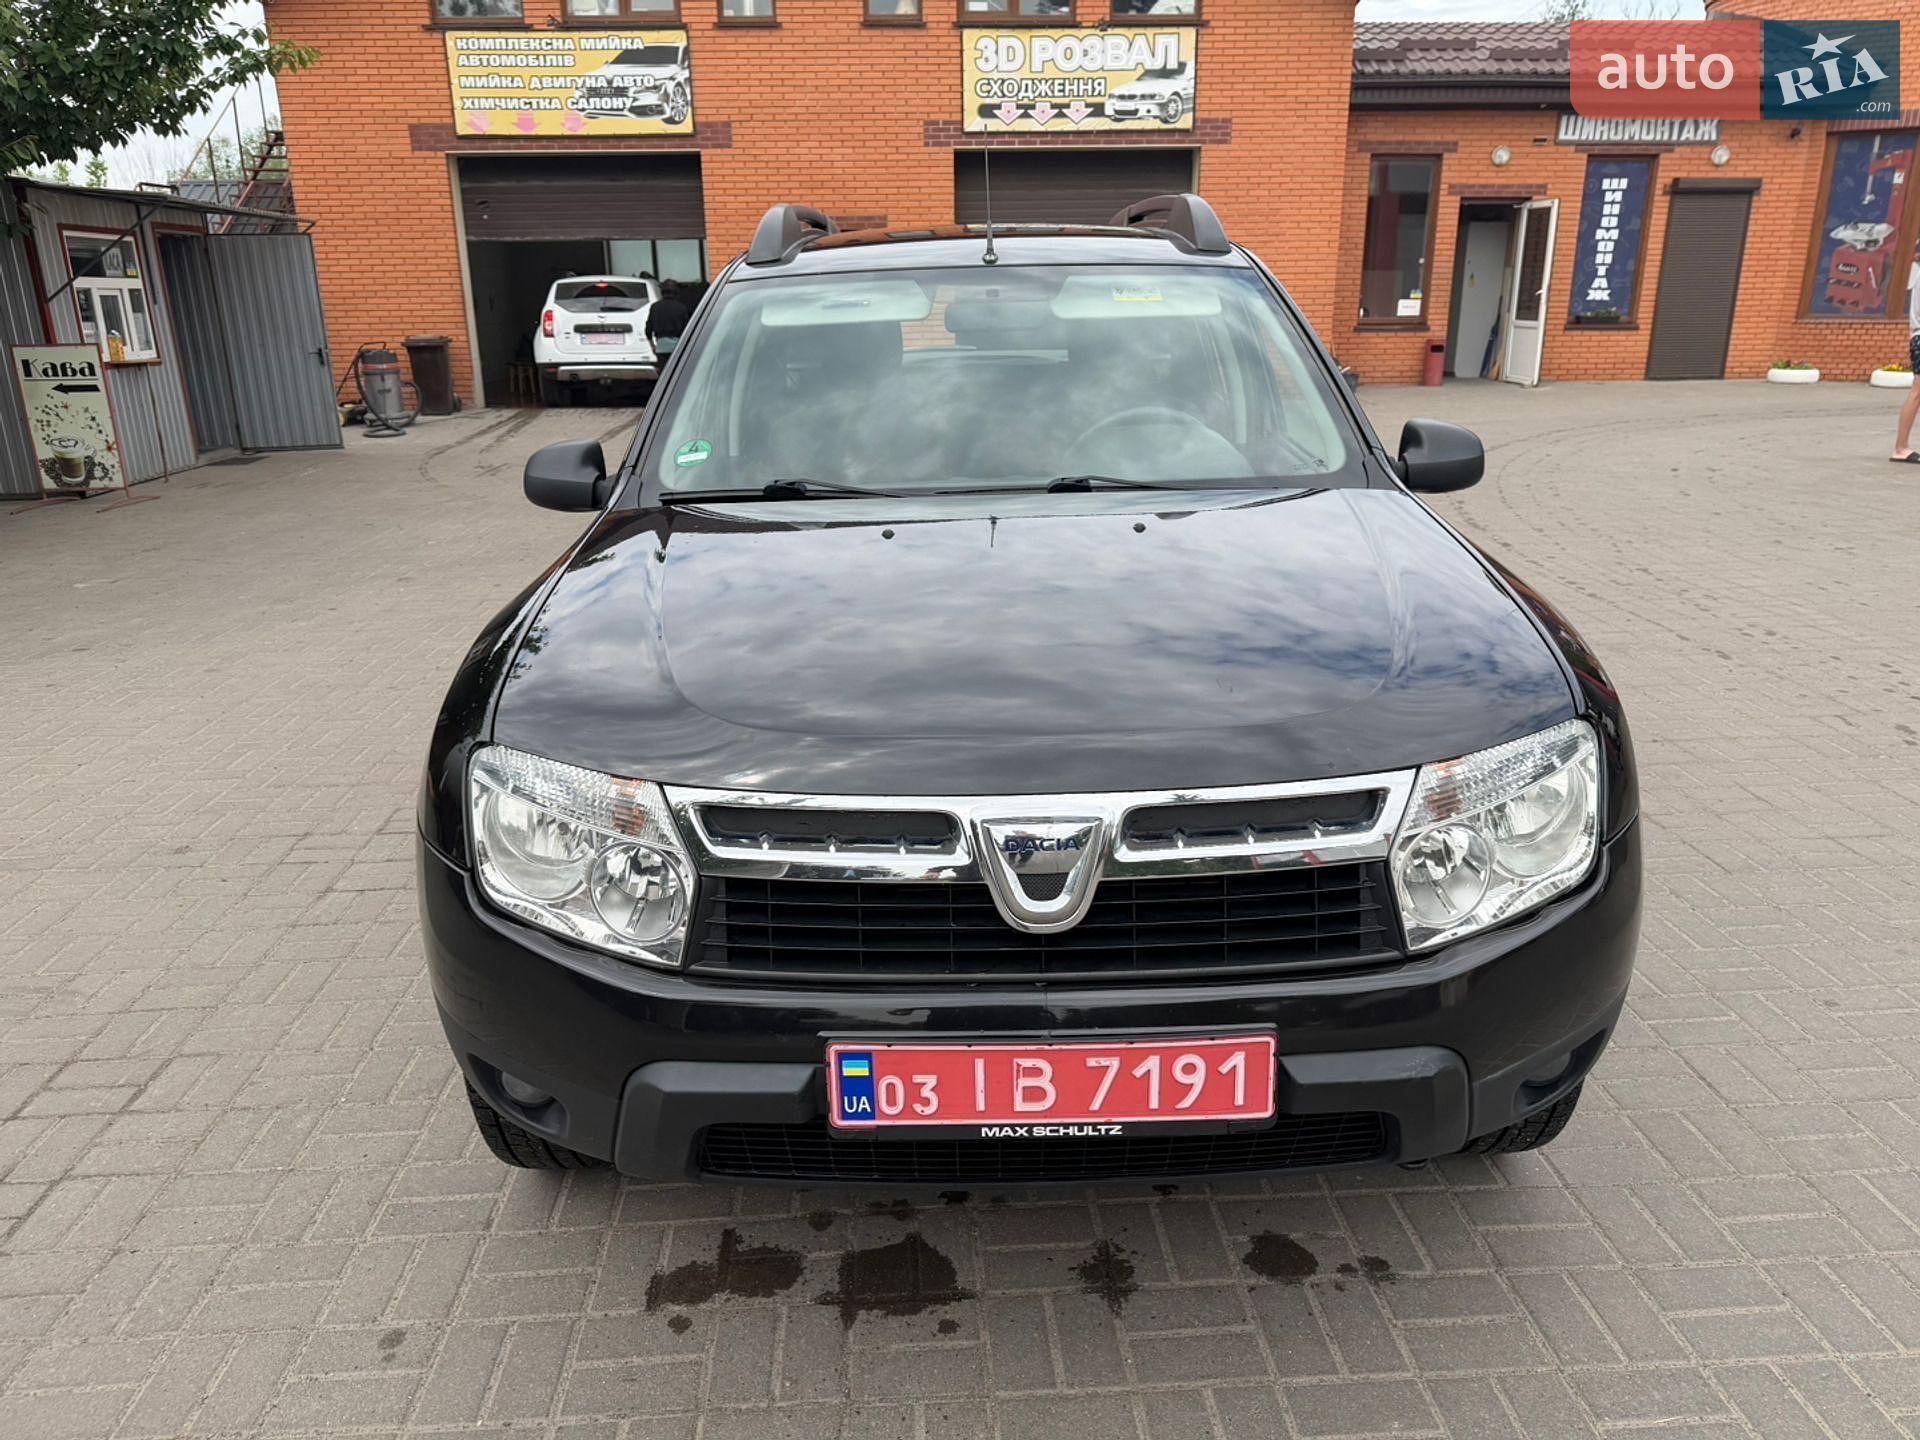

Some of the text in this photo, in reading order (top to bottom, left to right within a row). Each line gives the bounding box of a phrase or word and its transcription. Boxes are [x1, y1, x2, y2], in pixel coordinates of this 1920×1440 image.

[456, 36, 644, 50] КОМПЛЕКСНА МИЙКА
[975, 33, 1179, 72] 3D РОЗВАЛ
[457, 55, 575, 67] АВТОМОБІЛІВ
[459, 73, 655, 90] МИЙКА ДВИГУНА АВТО
[976, 77, 1107, 100] СХОДЖЕННЯ
[462, 96, 634, 111] ХІМЧИСТКА САЛОНУ
[1558, 115, 1719, 141] ШИНОМОНТАЖ
[1585, 178, 1628, 301] ШИНОМОНТАЖ
[21, 358, 97, 378] Кава
[1004, 837, 1081, 852] DACIA
[878, 1074, 940, 1116] 03
[1085, 1050, 1246, 1112] 7191
[842, 1095, 872, 1114] UA
[981, 1124, 1123, 1138] MAX SCHULTZ
